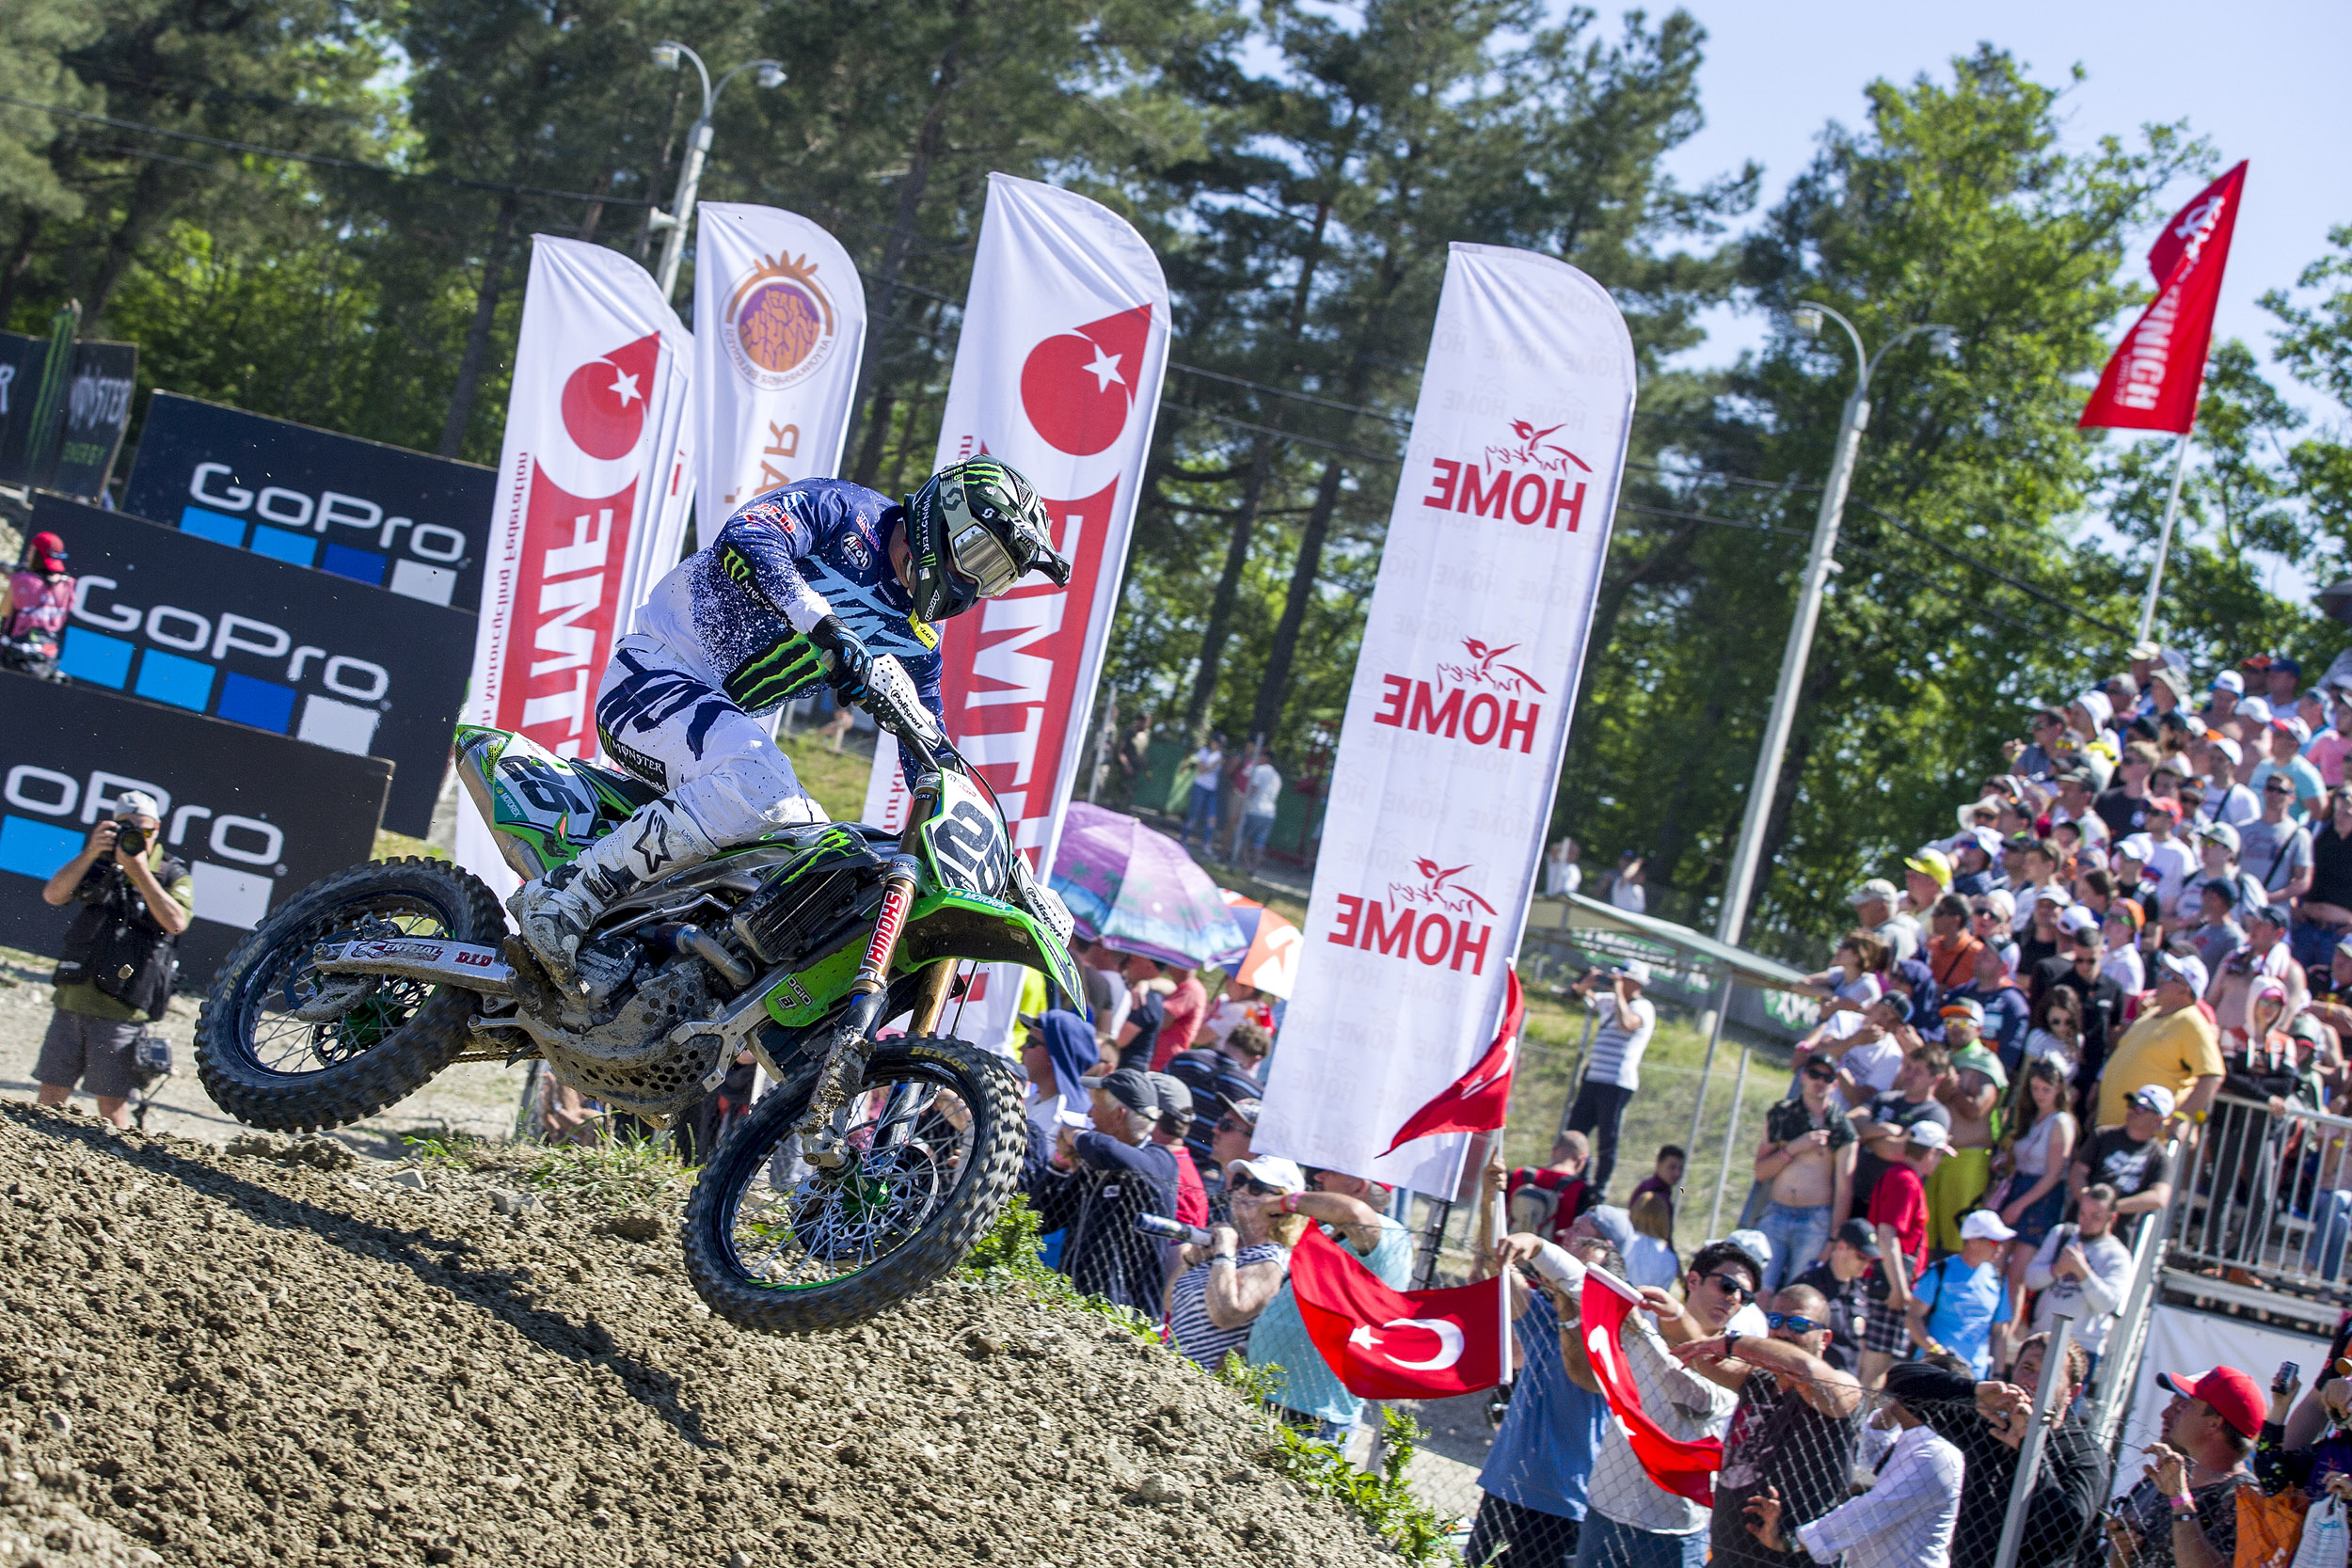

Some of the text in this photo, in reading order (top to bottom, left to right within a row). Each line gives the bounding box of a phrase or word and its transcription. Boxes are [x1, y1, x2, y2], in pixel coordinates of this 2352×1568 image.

[190, 462, 467, 562] GoPro
[843, 534, 870, 569] Airoh
[924, 589, 941, 622] Airoh
[74, 575, 389, 702] GoPro
[890, 689, 924, 731] Polisport
[612, 739, 664, 775] MONSTER
[501, 792, 522, 818] MOTOREX
[962, 892, 1013, 911] MOTOREX
[866, 890, 906, 965] SHOWA
[910, 1046, 969, 1071] DUNLOP
